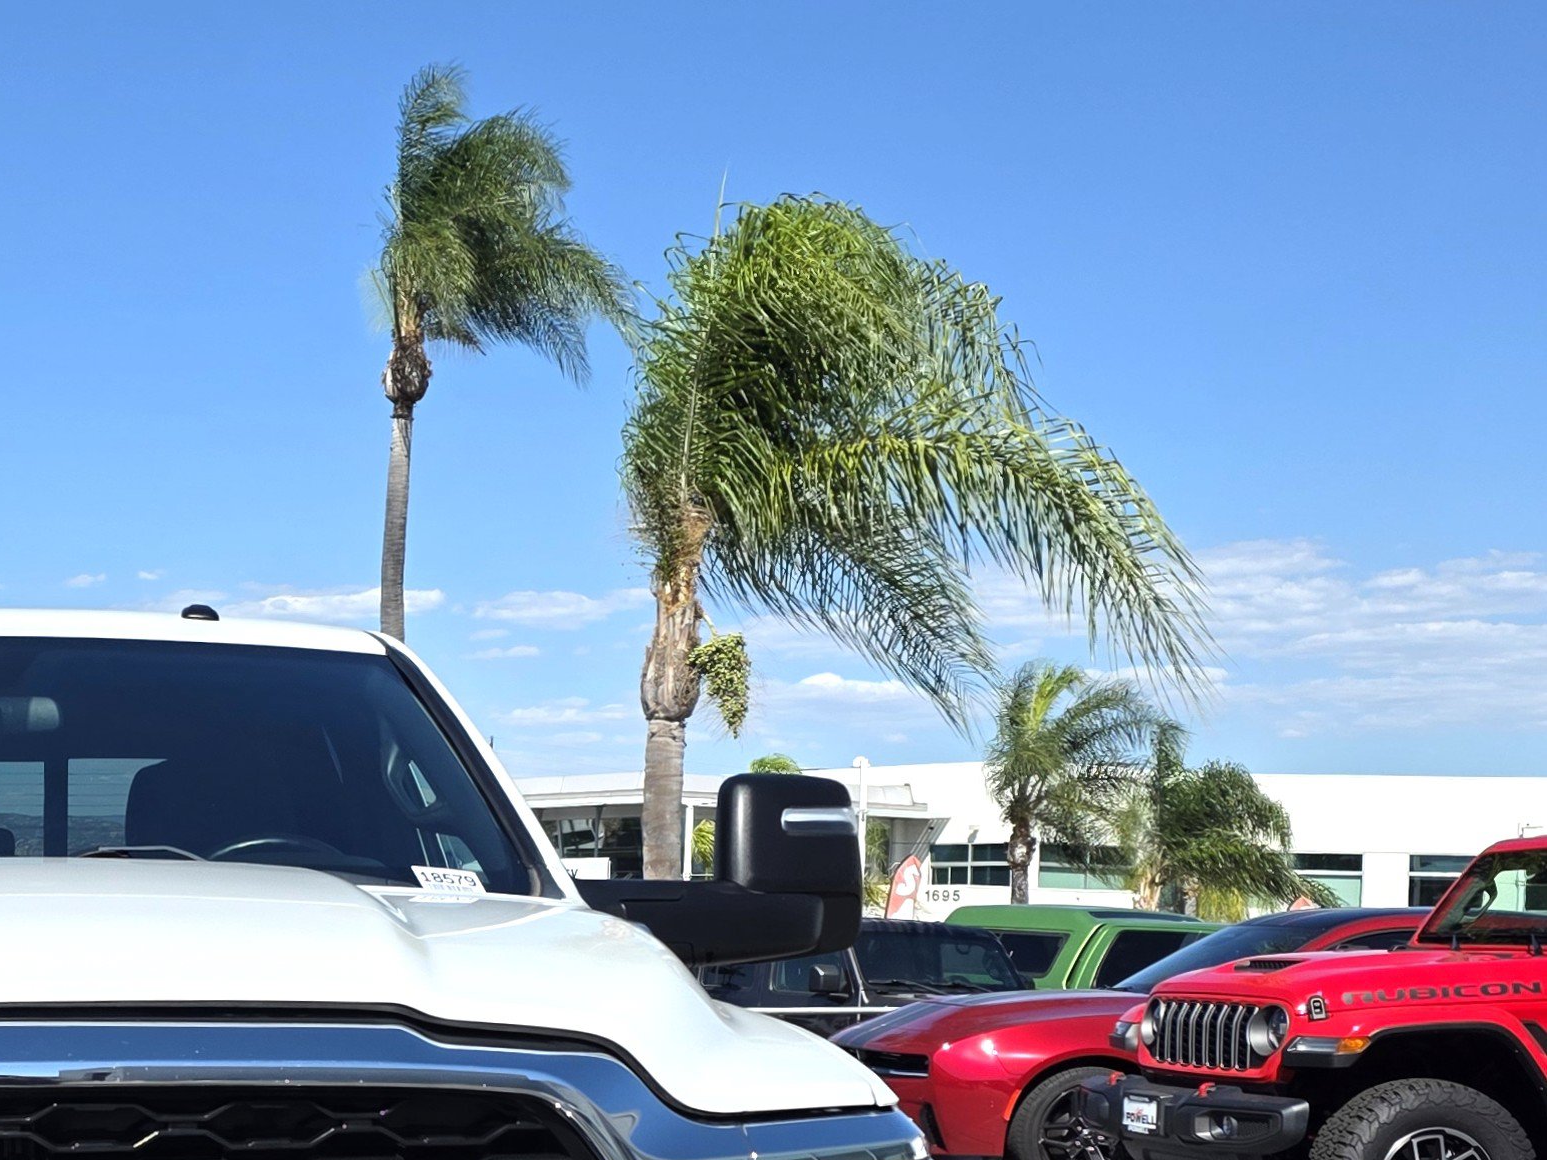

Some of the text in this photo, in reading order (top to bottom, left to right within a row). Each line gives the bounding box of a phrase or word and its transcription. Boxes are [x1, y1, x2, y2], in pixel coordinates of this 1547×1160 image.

[420, 871, 477, 887] 18579
[925, 889, 961, 902] 1695
[1341, 981, 1542, 1005] RUBICON
